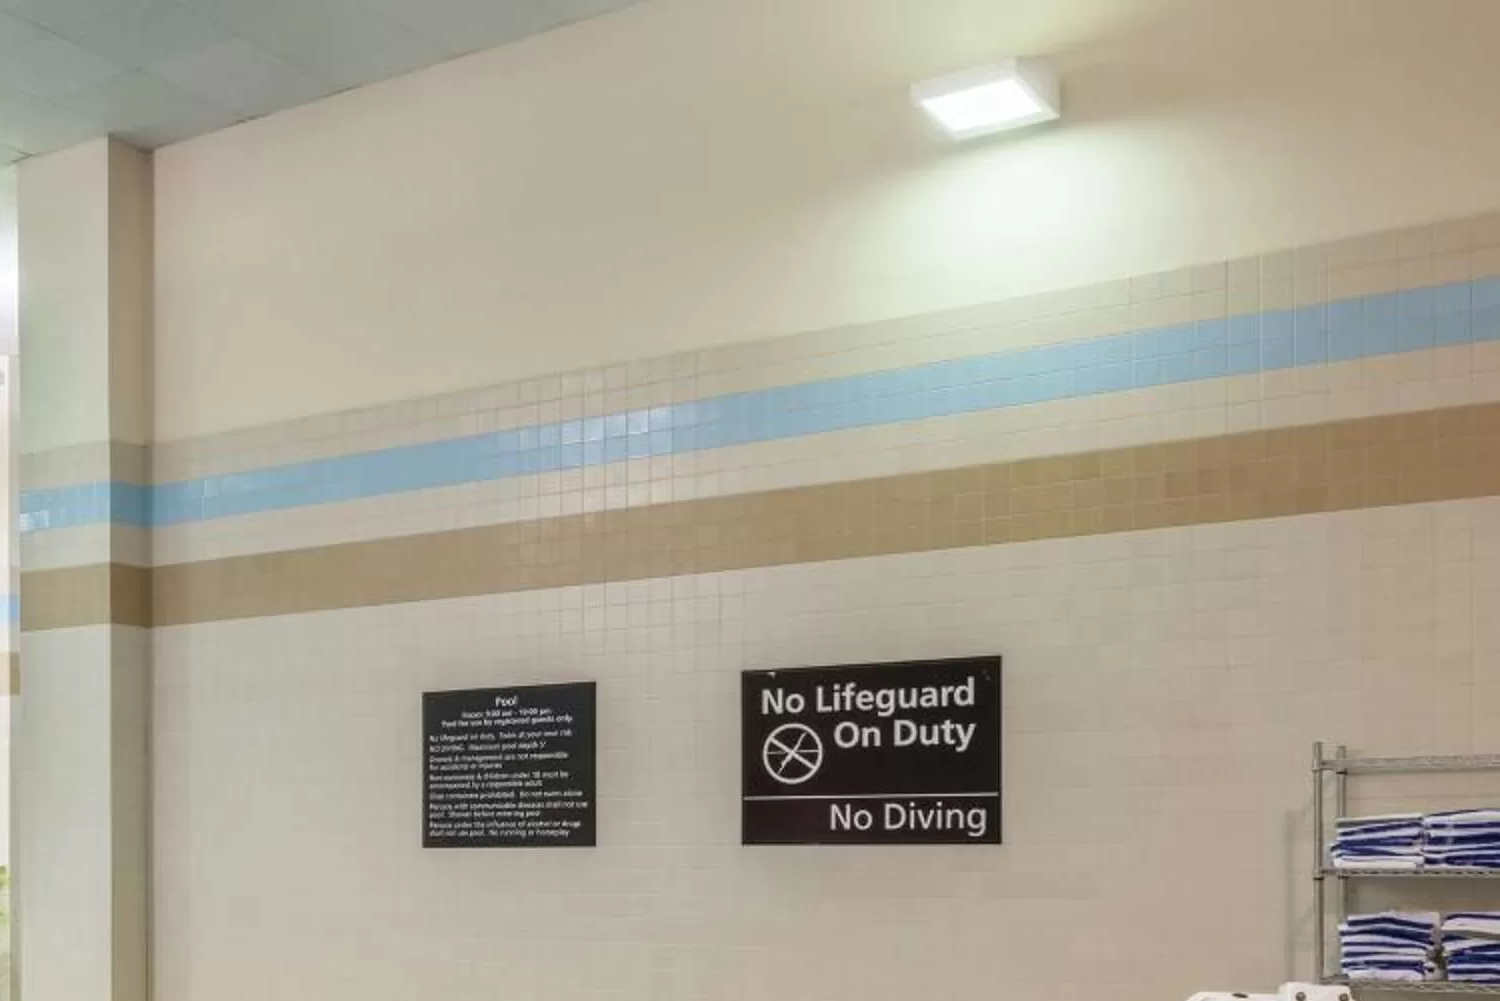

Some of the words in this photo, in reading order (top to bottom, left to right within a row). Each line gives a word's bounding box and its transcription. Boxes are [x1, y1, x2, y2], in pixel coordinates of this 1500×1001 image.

[495, 696, 518, 707] Pool
[761, 688, 805, 715] No
[816, 675, 975, 718] Lifeguard
[834, 721, 881, 748] On
[893, 719, 977, 753] Duty
[830, 803, 873, 831] No
[884, 801, 987, 837] Diving
